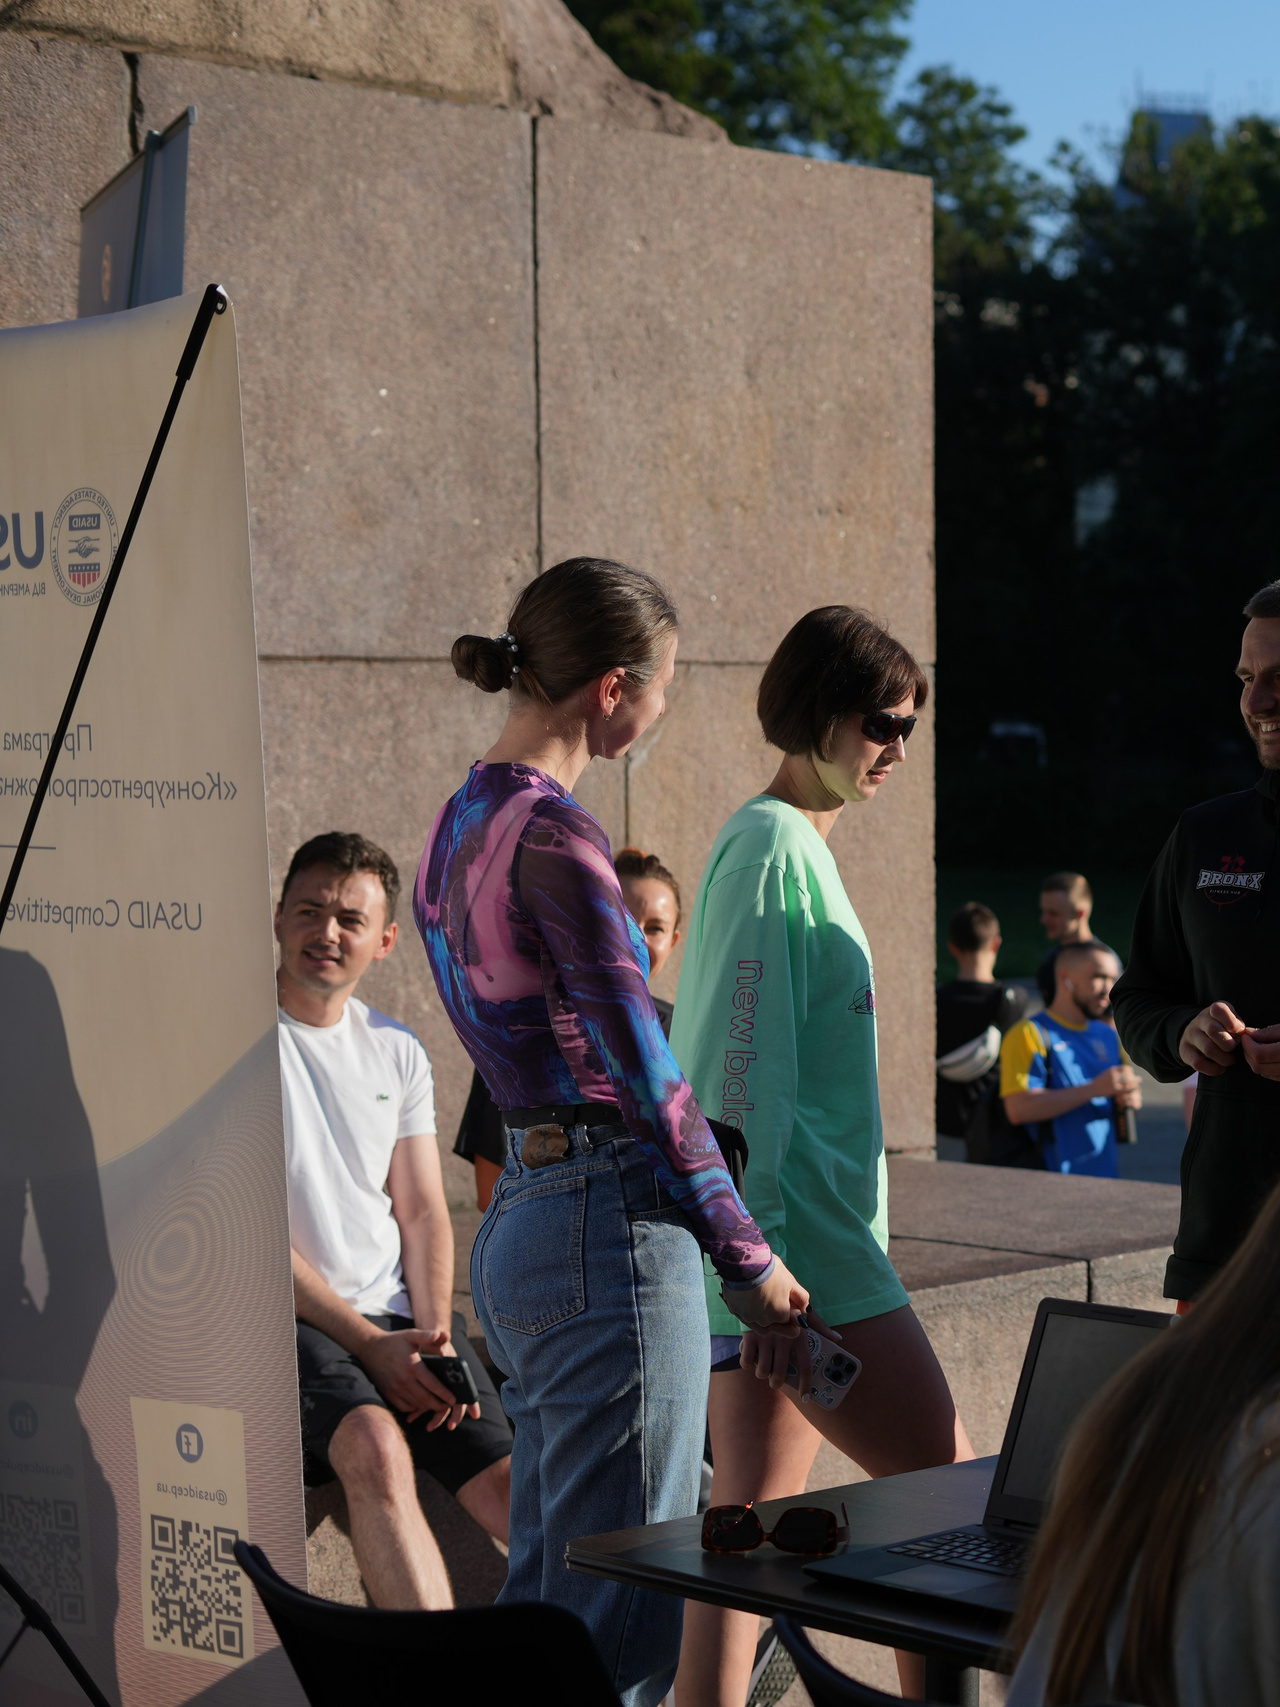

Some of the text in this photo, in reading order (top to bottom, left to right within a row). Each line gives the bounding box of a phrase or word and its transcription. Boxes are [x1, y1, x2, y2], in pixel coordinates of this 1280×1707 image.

[1196, 869, 1265, 891] BRONX
[721, 960, 763, 1130] new bala
